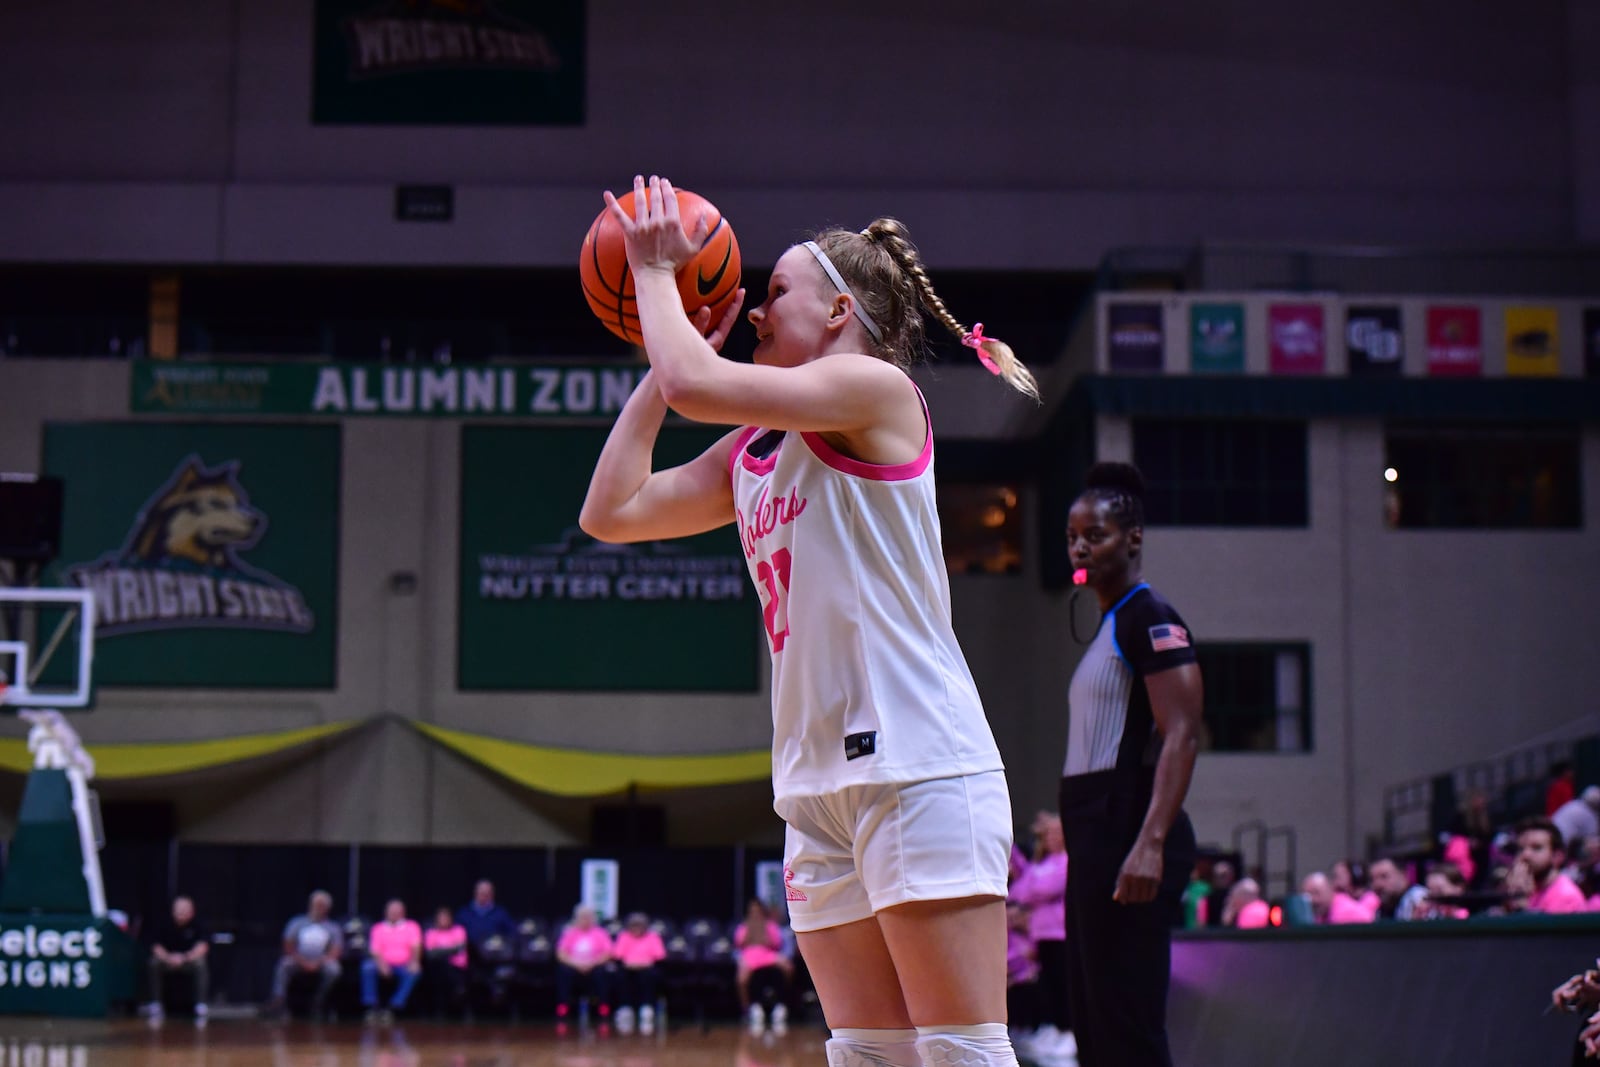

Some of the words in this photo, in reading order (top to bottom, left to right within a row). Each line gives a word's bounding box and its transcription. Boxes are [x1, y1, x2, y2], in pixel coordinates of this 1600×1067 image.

[313, 367, 517, 412] ALUMNI
[530, 367, 649, 412] ZON
[76, 567, 219, 625] WRIGHT
[479, 574, 610, 599] NUTTER
[616, 574, 744, 599] CENTER
[0, 923, 104, 959] elect
